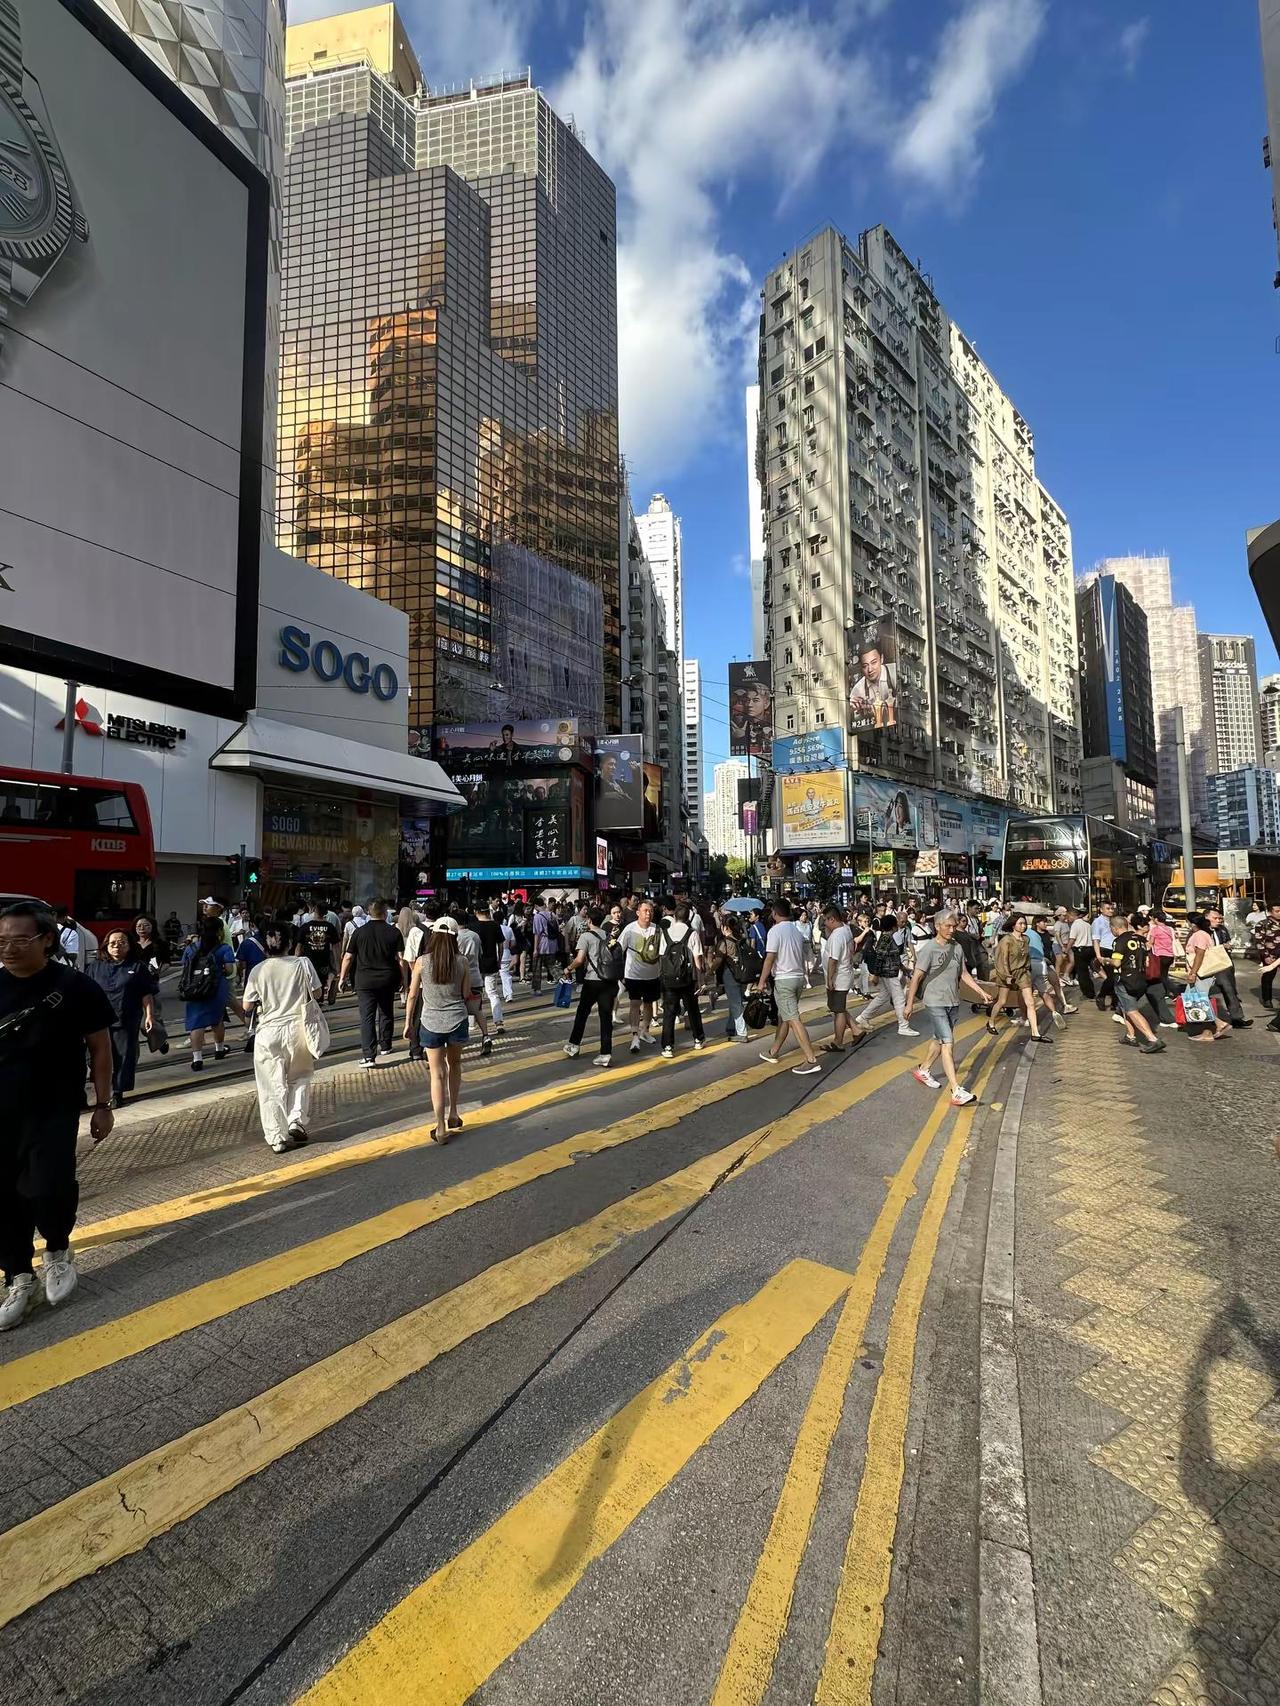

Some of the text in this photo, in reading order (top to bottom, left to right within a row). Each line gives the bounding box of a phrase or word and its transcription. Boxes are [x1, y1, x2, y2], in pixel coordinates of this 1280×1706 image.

[279, 625, 398, 701] SOGO
[1213, 659, 1248, 669] Rosedale
[107, 713, 187, 740] MITSUBISHI
[106, 726, 177, 750] ELECTRIC
[272, 816, 300, 832] SOGO
[91, 838, 127, 852] KMB
[272, 833, 349, 853] REWARDS DAYS
[1050, 858, 1070, 869] 936
